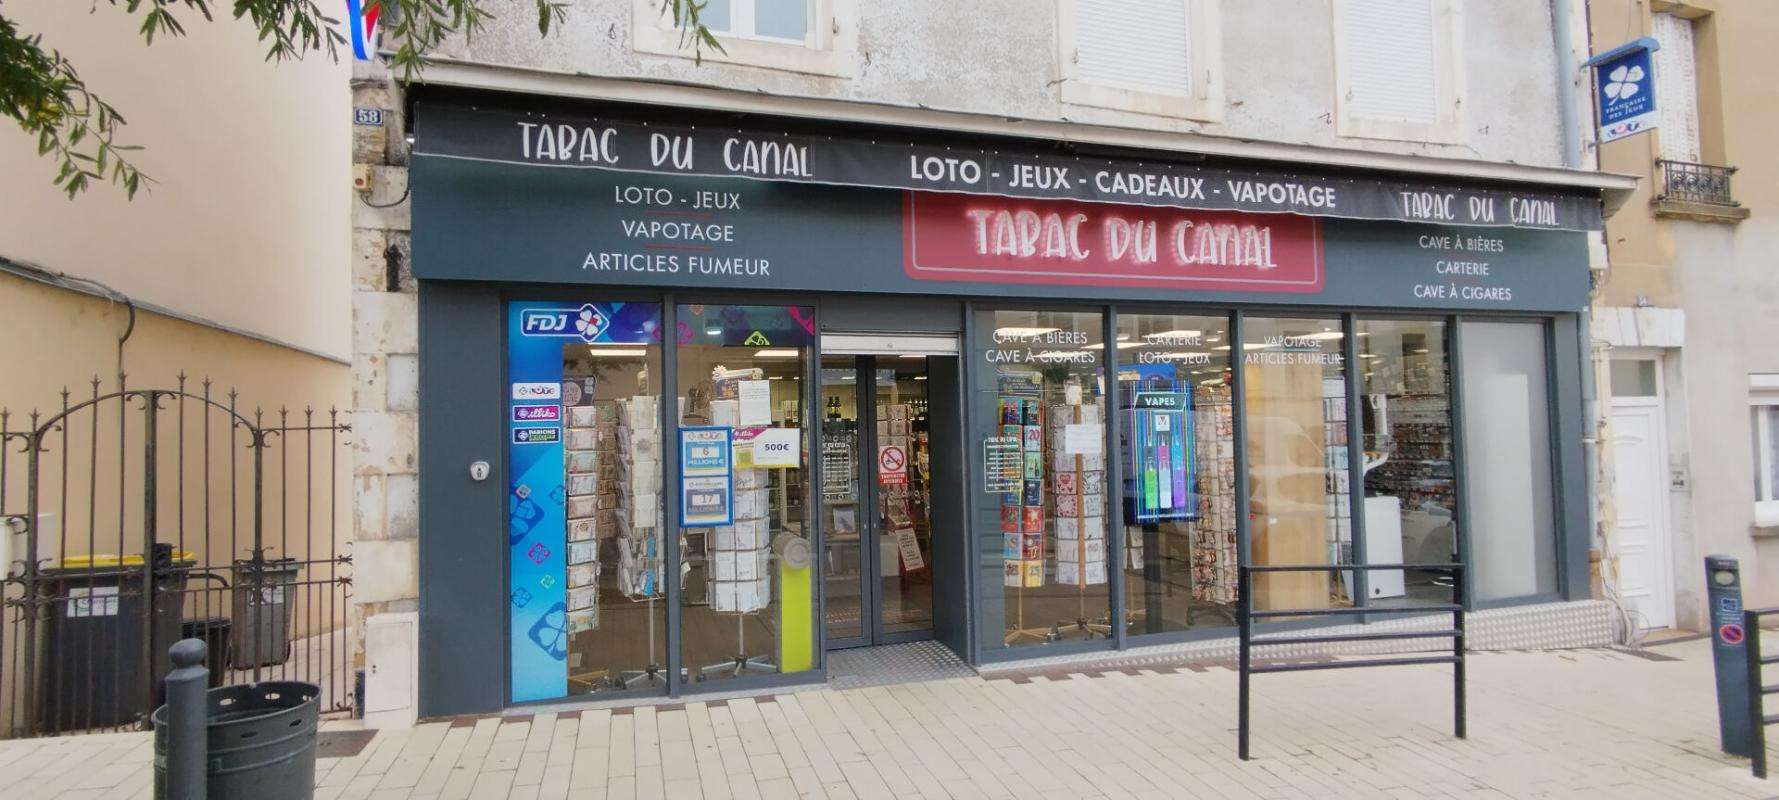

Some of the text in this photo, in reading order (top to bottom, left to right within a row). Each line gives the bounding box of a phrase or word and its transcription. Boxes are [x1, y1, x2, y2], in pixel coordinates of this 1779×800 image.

[358, 110, 377, 123] 58
[517, 121, 813, 177] TABAC DU CANAL
[911, 155, 981, 184] LOTO
[1009, 164, 1071, 189] JEUX
[1095, 170, 1205, 200] CADEAUX
[1227, 180, 1336, 208] VAPOTAGE
[615, 185, 673, 205] LOTO
[693, 191, 741, 210] JEUX
[1400, 191, 1560, 226] TABAC DU CANAL
[621, 219, 734, 242] VAPOTAGE
[966, 208, 1277, 269] TABAC DU CANAL
[1419, 233, 1504, 252] CAVE À BIÈRES
[582, 251, 770, 276] ARTICLES FUMEUR
[1436, 260, 1489, 275] CARTERIE
[1414, 282, 1512, 301] CAVE À CIGARES
[526, 314, 567, 331] FDJ
[992, 330, 1027, 344] CAVE
[1147, 335, 1202, 347] CARTERIE
[1264, 335, 1322, 348] VAPOTAGE
[985, 347, 1096, 364] CAVE À CIGARES
[1139, 352, 1172, 364] LOTO
[1182, 352, 1211, 365] JEUX
[1245, 353, 1340, 366] ARTICLES FUMEUR
[1145, 397, 1175, 406] VAPES
[702, 448, 710, 457] 6
[764, 443, 790, 451] 500€
